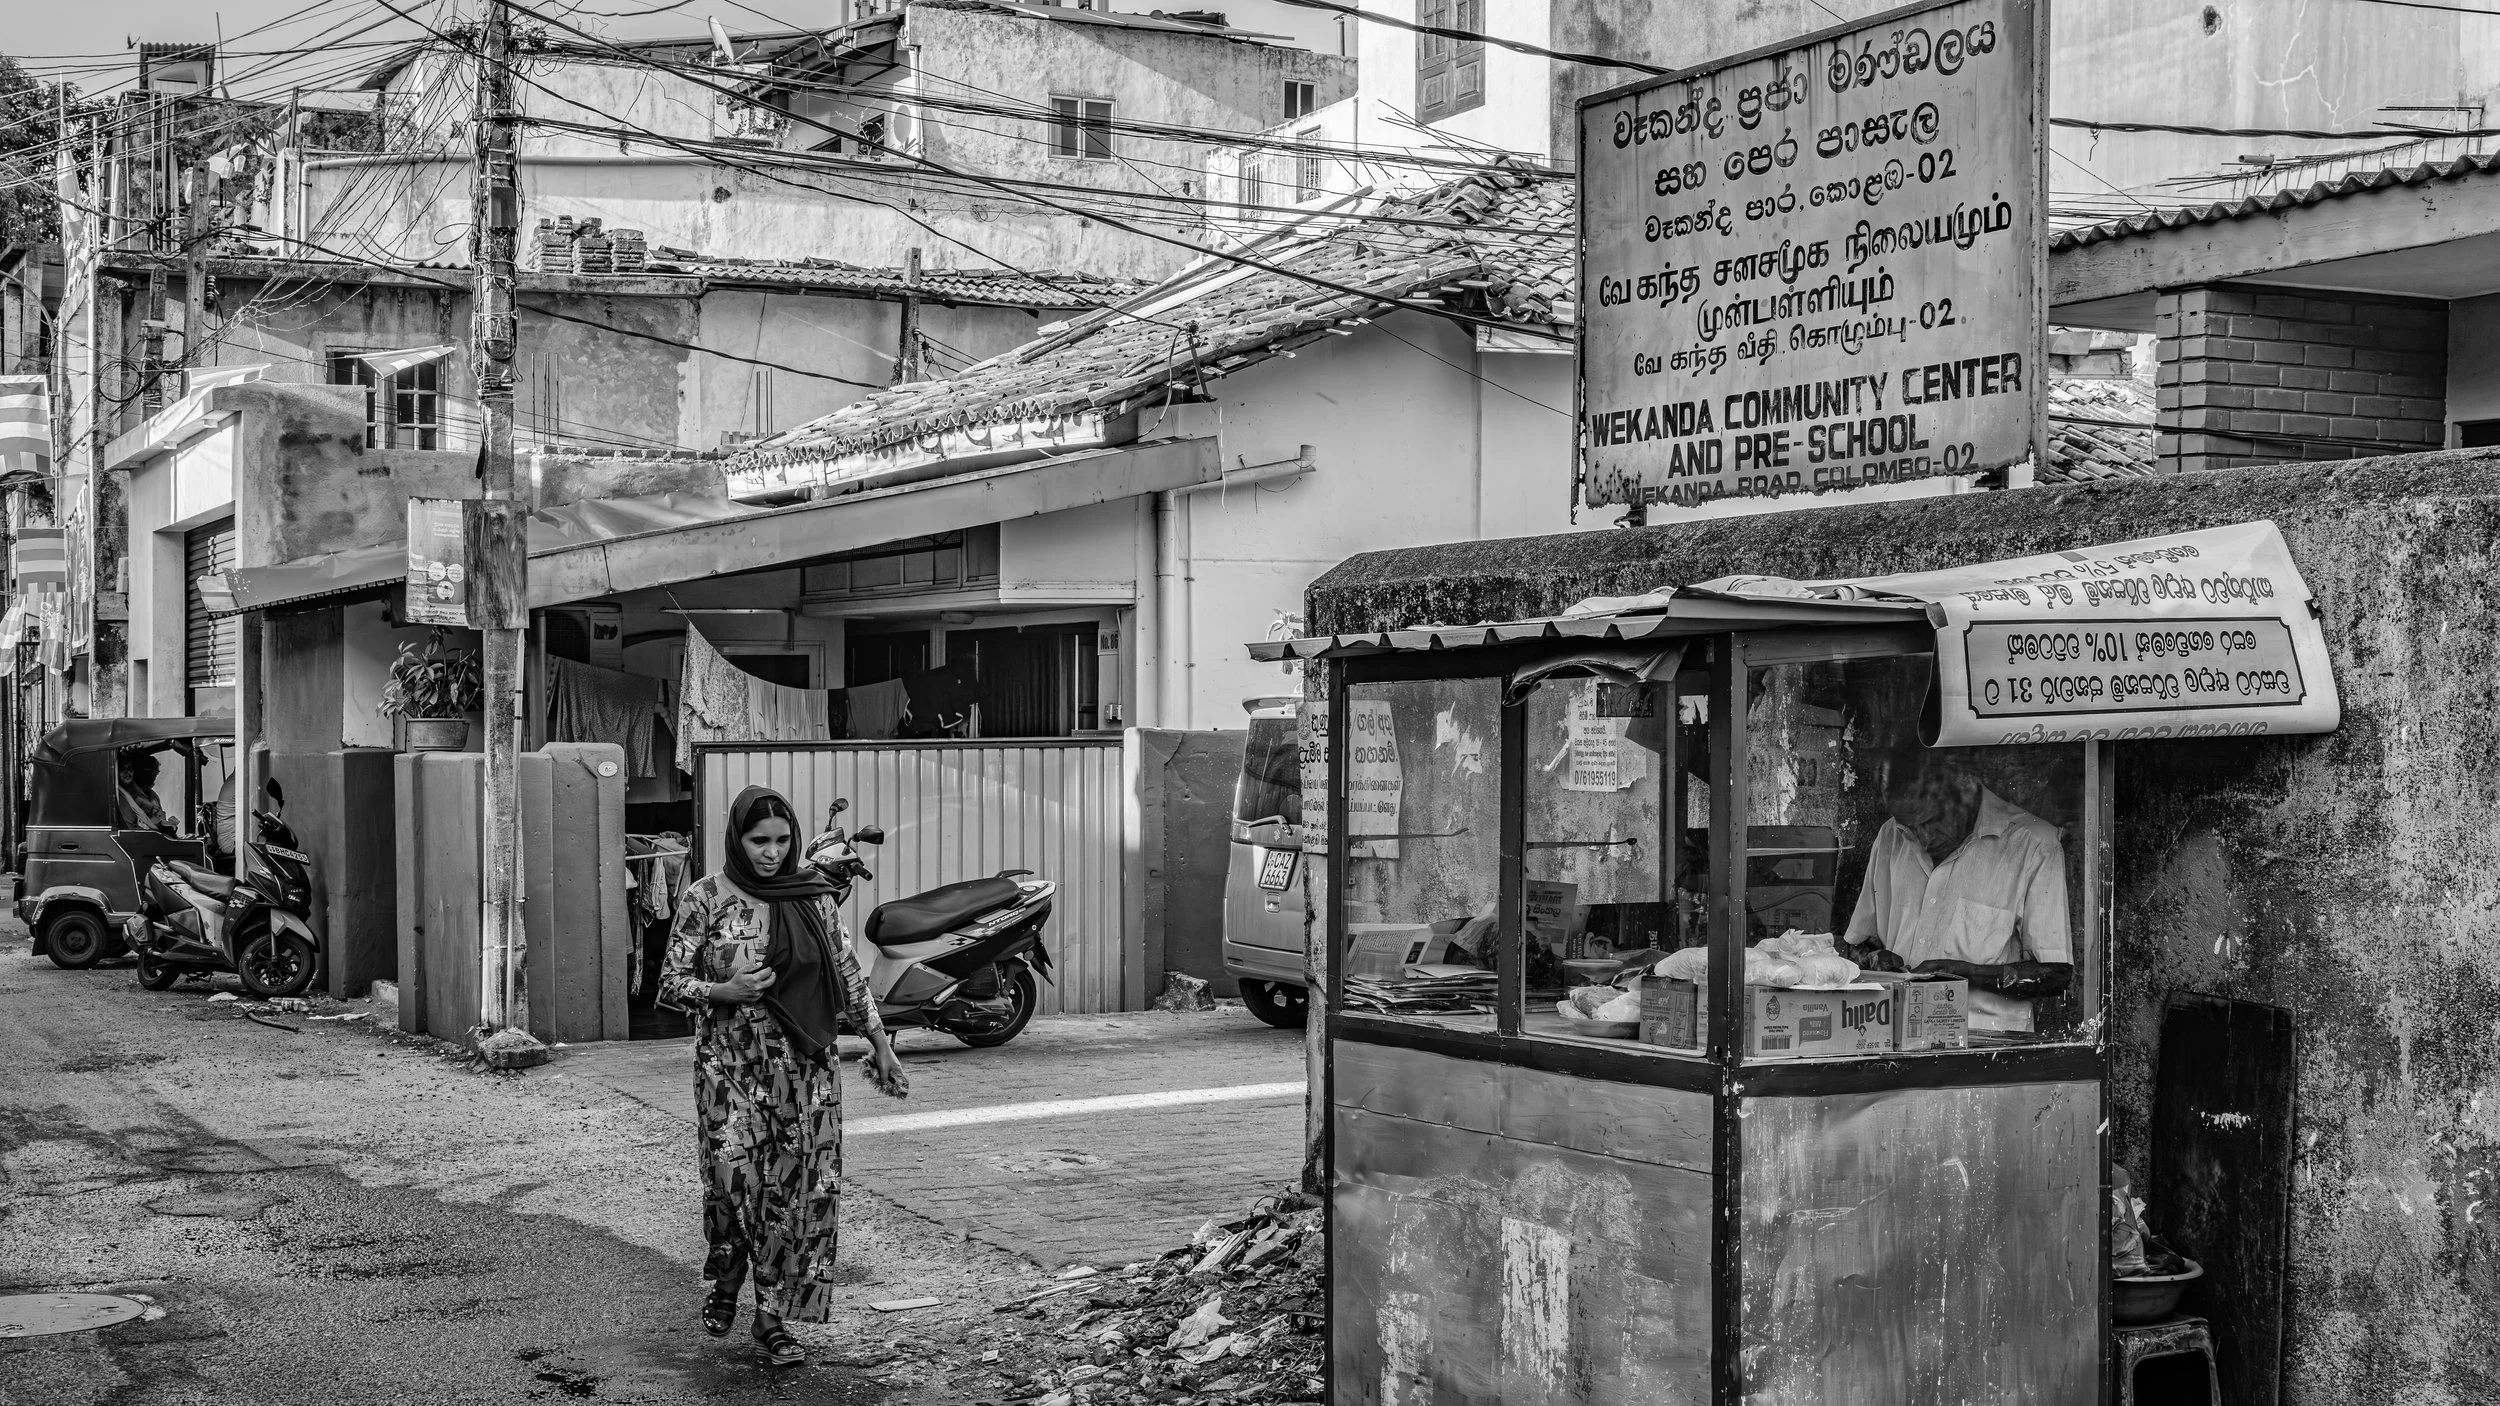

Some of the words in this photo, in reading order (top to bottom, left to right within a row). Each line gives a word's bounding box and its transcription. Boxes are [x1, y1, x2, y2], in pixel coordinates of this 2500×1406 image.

[1655, 158, 1707, 198] සහ
[1724, 126, 1798, 181] පෙර
[1845, 192, 2012, 272] நிலையமும்
[1697, 266, 1894, 342] முன்பள்ளியும்
[1591, 398, 1713, 448] WEKANDA
[1724, 371, 1888, 431] COMMUNITY
[1901, 352, 2022, 406] CENTER
[1667, 432, 1723, 480] AND
[1733, 413, 1929, 472] PRE-SCHOOL
[1738, 471, 1801, 497] ROAD
[2074, 559, 2118, 577] 5%
[2085, 631, 2128, 662] 10%
[2221, 629, 2256, 656] පෙර
[1984, 678, 2000, 706] ට
[2007, 677, 2033, 702] 31
[1274, 853, 1292, 869] CAZ
[1265, 869, 1287, 885] 6663
[1802, 1003, 1829, 1013] Vanilla
[1841, 998, 1890, 1032] Daily
